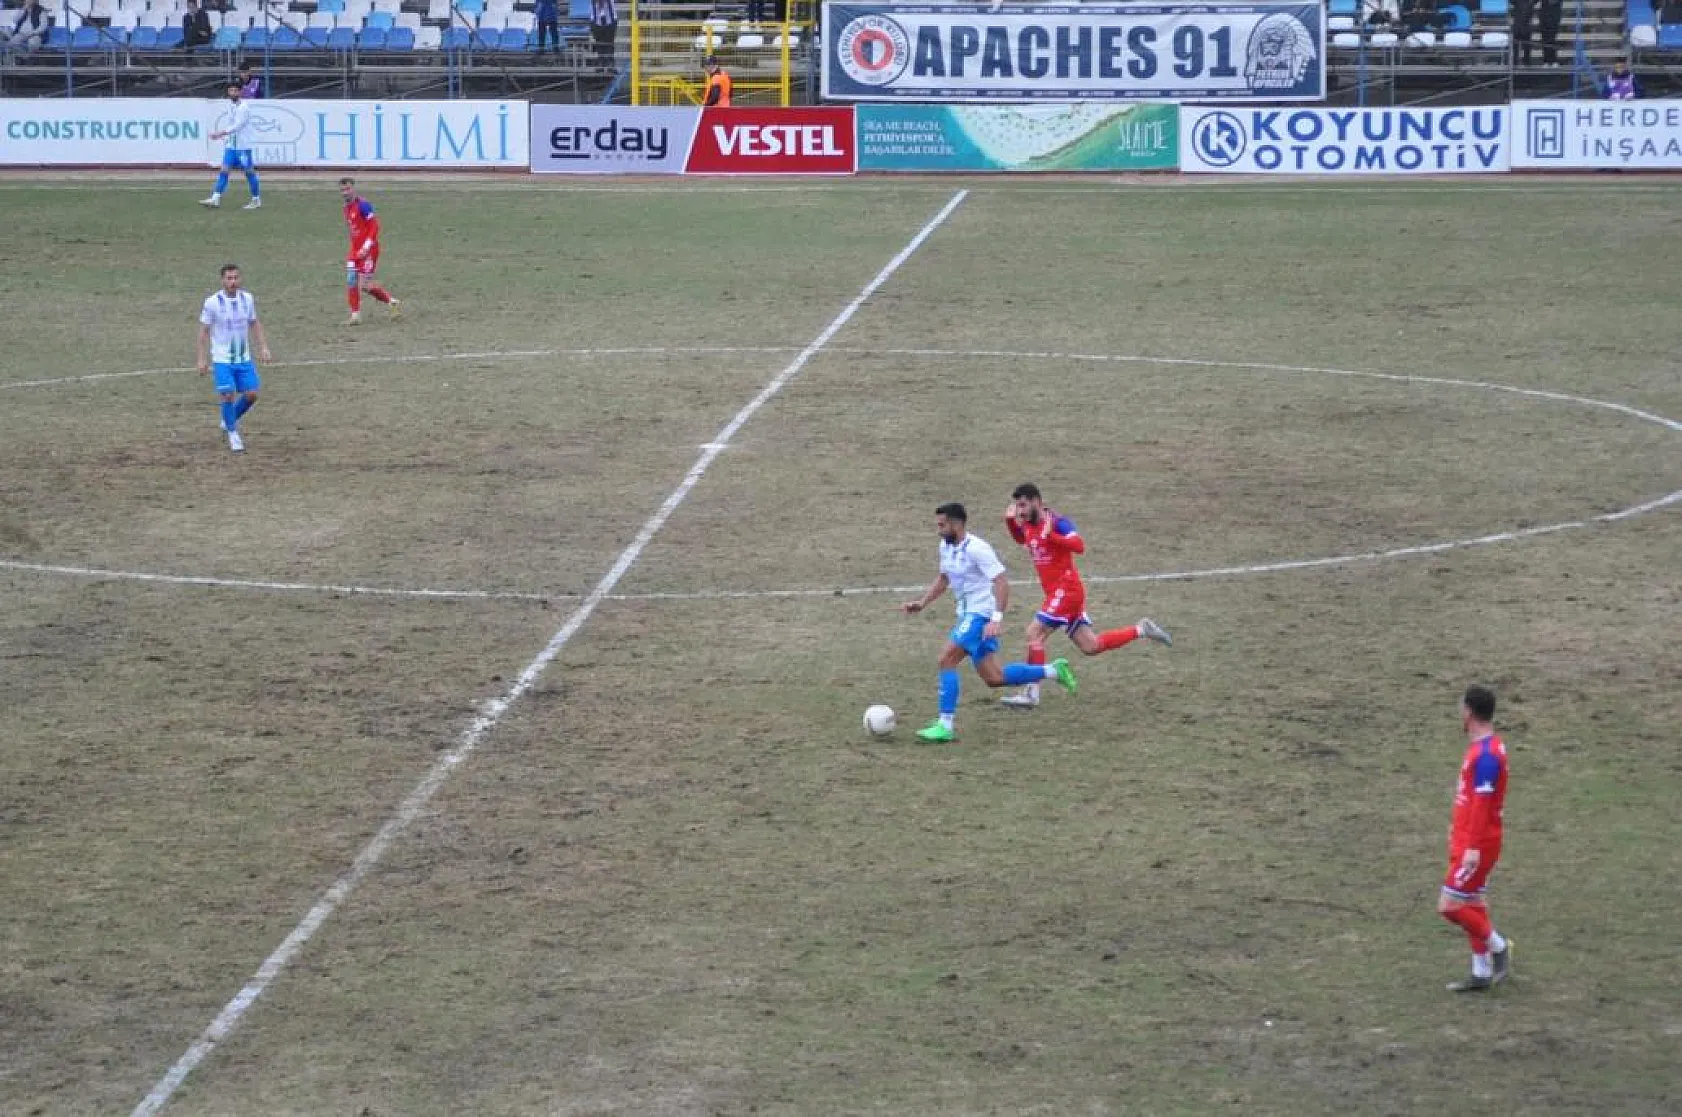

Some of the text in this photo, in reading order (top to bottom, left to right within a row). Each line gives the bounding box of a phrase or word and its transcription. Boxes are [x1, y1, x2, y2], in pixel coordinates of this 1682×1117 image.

[912, 24, 1237, 80] APACHES 91
[6, 120, 200, 140] CONSTRUCTION
[316, 104, 514, 160] HİLMİ
[1253, 111, 1501, 141] KOYUNCU
[1576, 108, 1680, 127] HERDE
[550, 119, 669, 161] erday
[713, 125, 844, 156] VESTEL
[1582, 134, 1682, 161] İNŞAA
